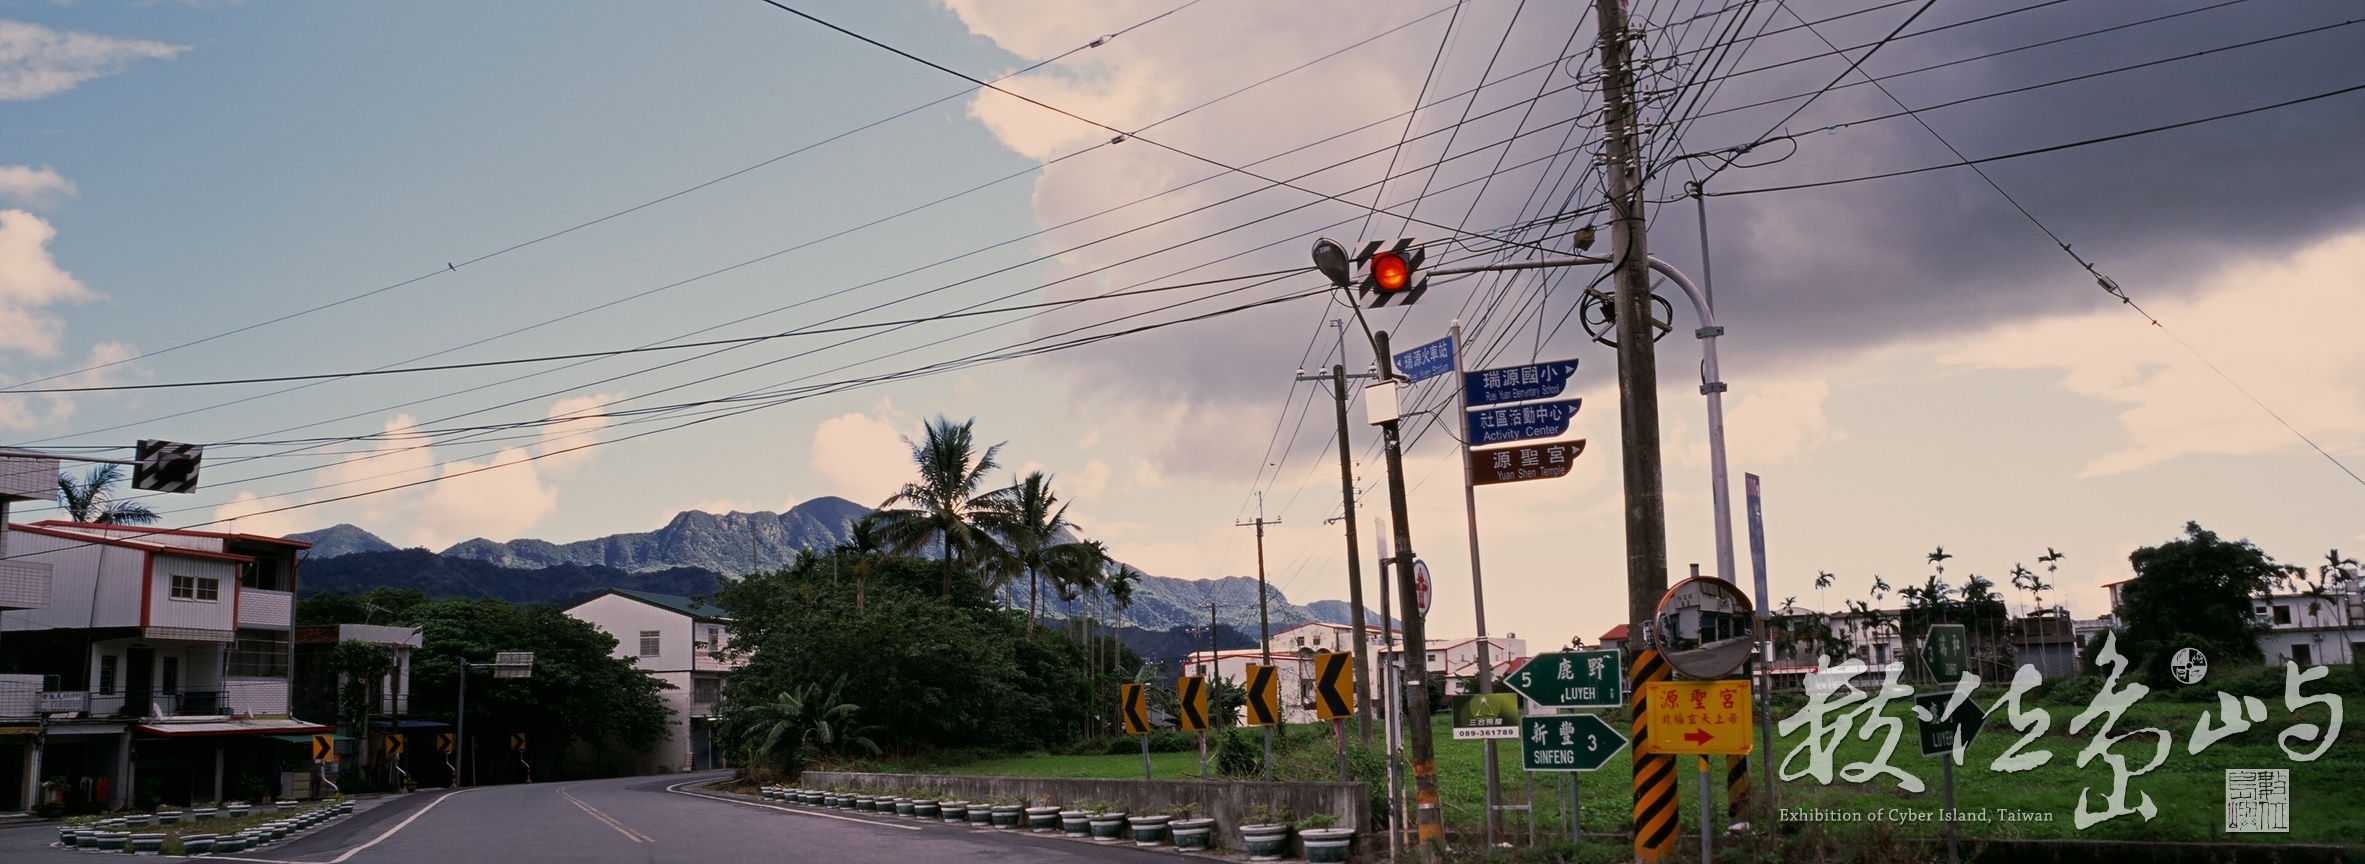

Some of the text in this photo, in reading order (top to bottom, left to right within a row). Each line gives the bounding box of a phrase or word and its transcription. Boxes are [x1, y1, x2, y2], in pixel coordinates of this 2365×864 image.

[1404, 340, 1448, 369] 瑞源火車站
[1482, 365, 1558, 389] 瑞源國小
[1485, 384, 1560, 401] Ruei Yuan Elementary School
[1480, 405, 1562, 429] 社區活動中心
[1483, 425, 1559, 441] Activity Center
[1493, 445, 1566, 469] 源聖宮
[1497, 465, 1565, 480] Yuan Shen Temple
[1557, 657, 1605, 680] 鹿野
[1521, 672, 1532, 688] 5
[1565, 687, 1596, 700] LUYEH
[1660, 688, 1738, 710] 源聖宮
[1662, 713, 1739, 725] 北極玄天上帝
[1459, 729, 1514, 737] 089-361789
[1531, 720, 1575, 746] 新豐
[1587, 734, 1597, 752] 3
[1533, 750, 1574, 764] SINFENG
